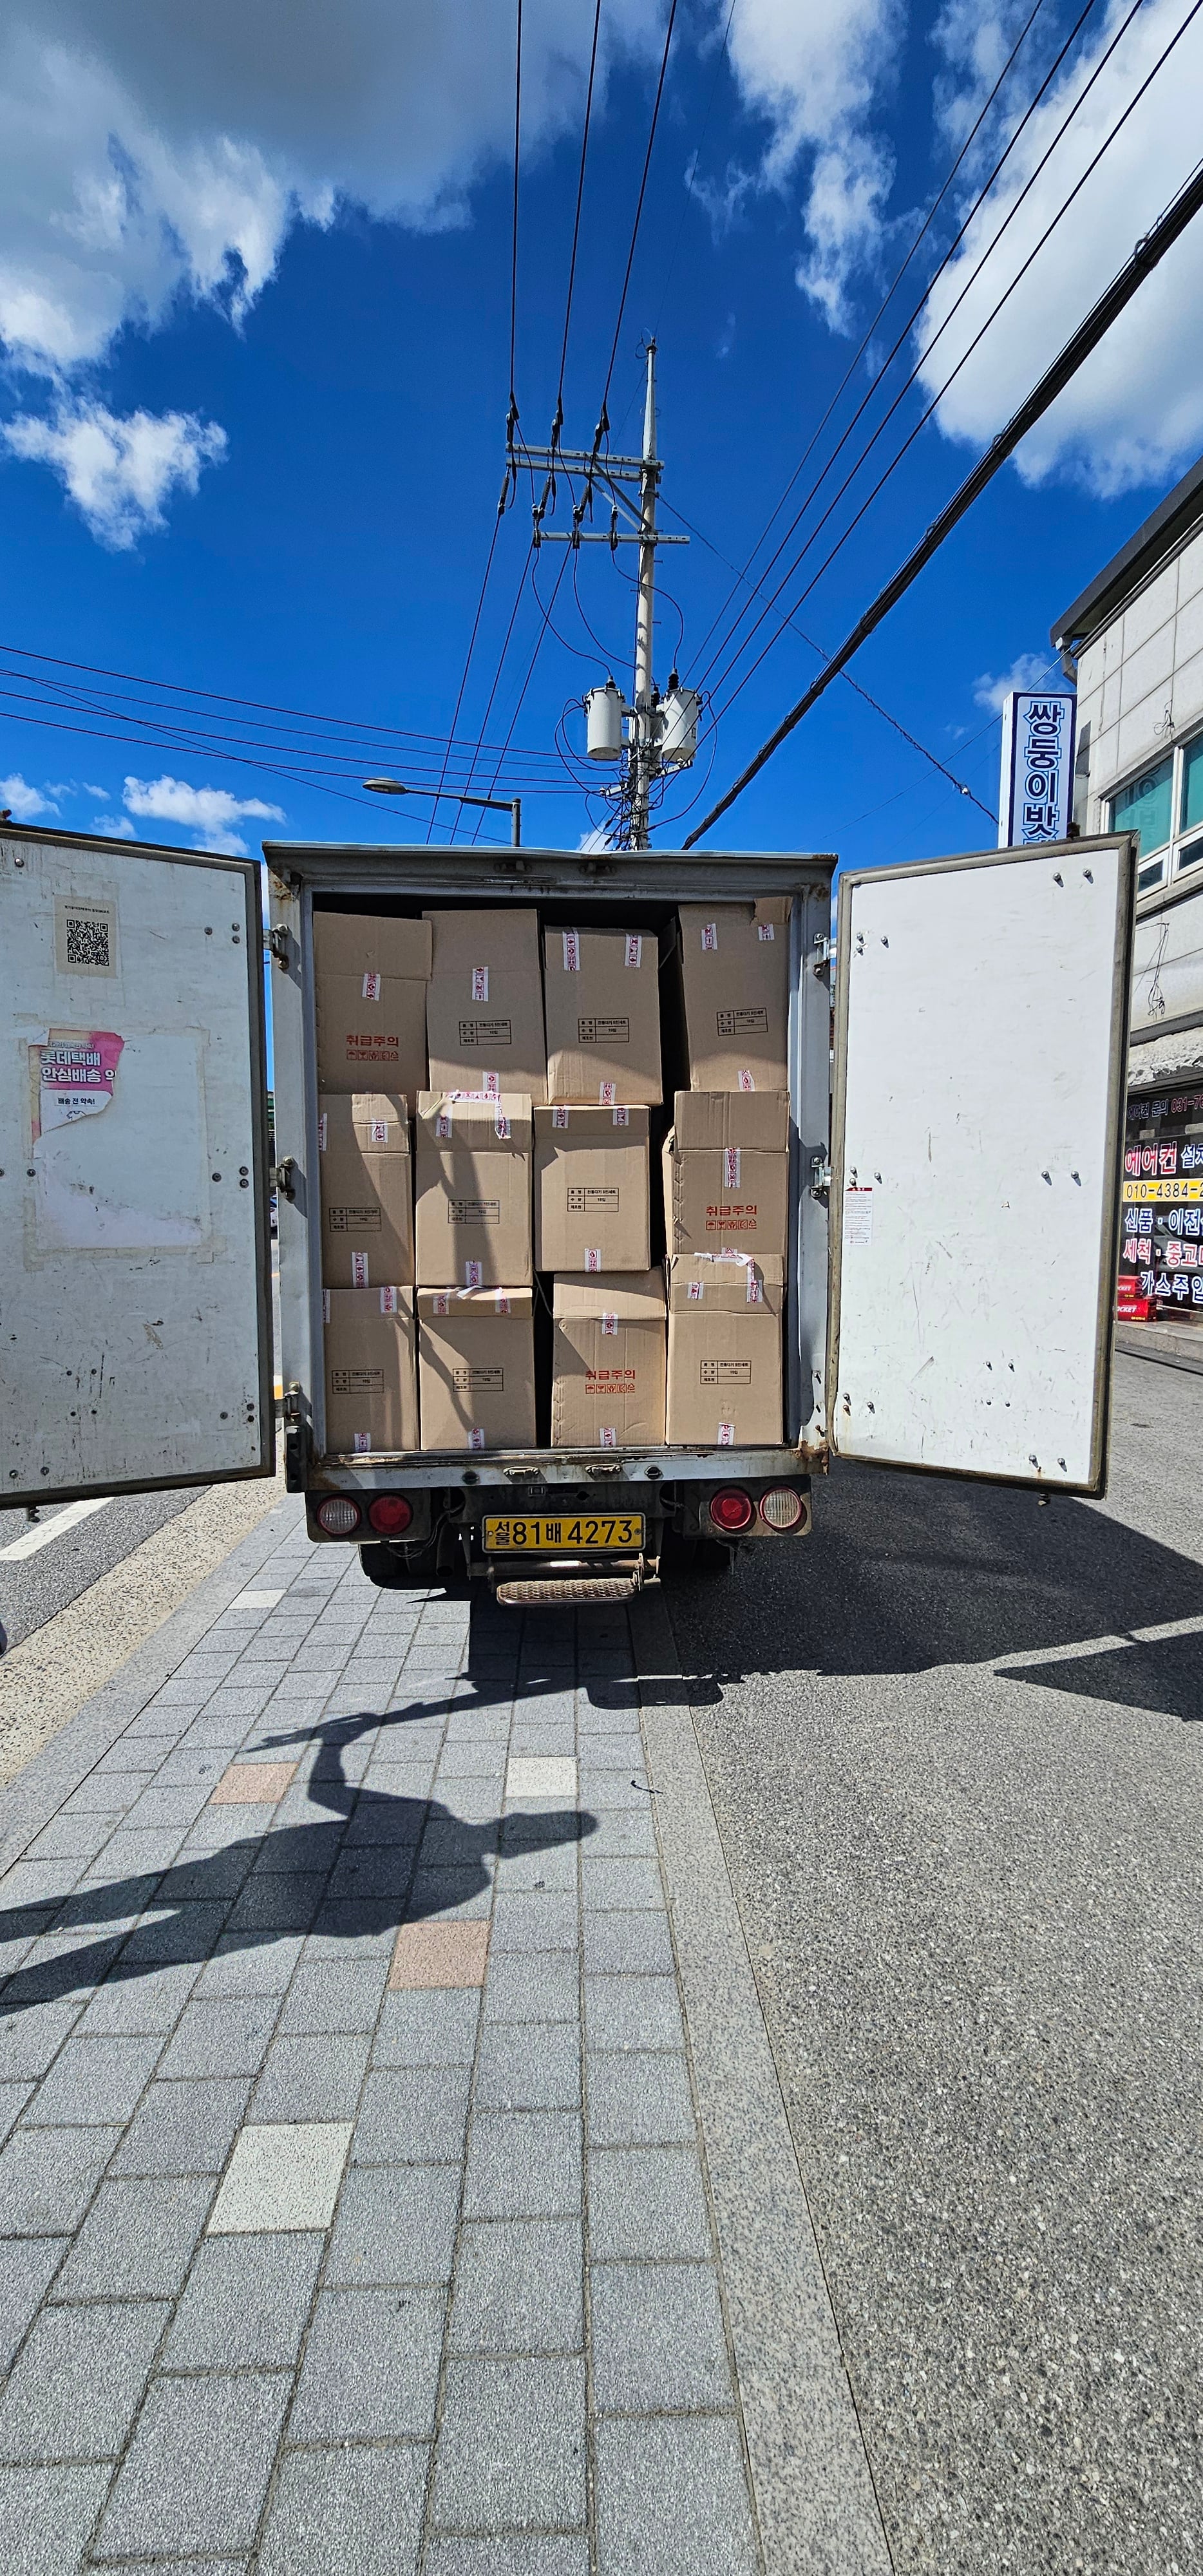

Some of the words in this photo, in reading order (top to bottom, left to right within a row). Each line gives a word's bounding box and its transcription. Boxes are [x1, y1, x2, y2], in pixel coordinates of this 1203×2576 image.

[1023, 701, 1065, 846] 쌍둥이밧
[346, 1035, 399, 1047] 취급주의
[41, 1050, 101, 1066] 롯데택배
[42, 1067, 102, 1083] 안심배송
[1127, 1102, 1150, 1121] 에어컨
[1151, 1099, 1169, 1117] 문의
[1125, 1141, 1177, 1177] 에어컨
[706, 1205, 757, 1216] 취급주의
[1124, 1208, 1153, 1233] 신품
[1168, 1208, 1203, 1236] 이전
[1122, 1238, 1151, 1264] 세척
[585, 1370, 635, 1380] 취급주의
[567, 1520, 632, 1544] 4273
